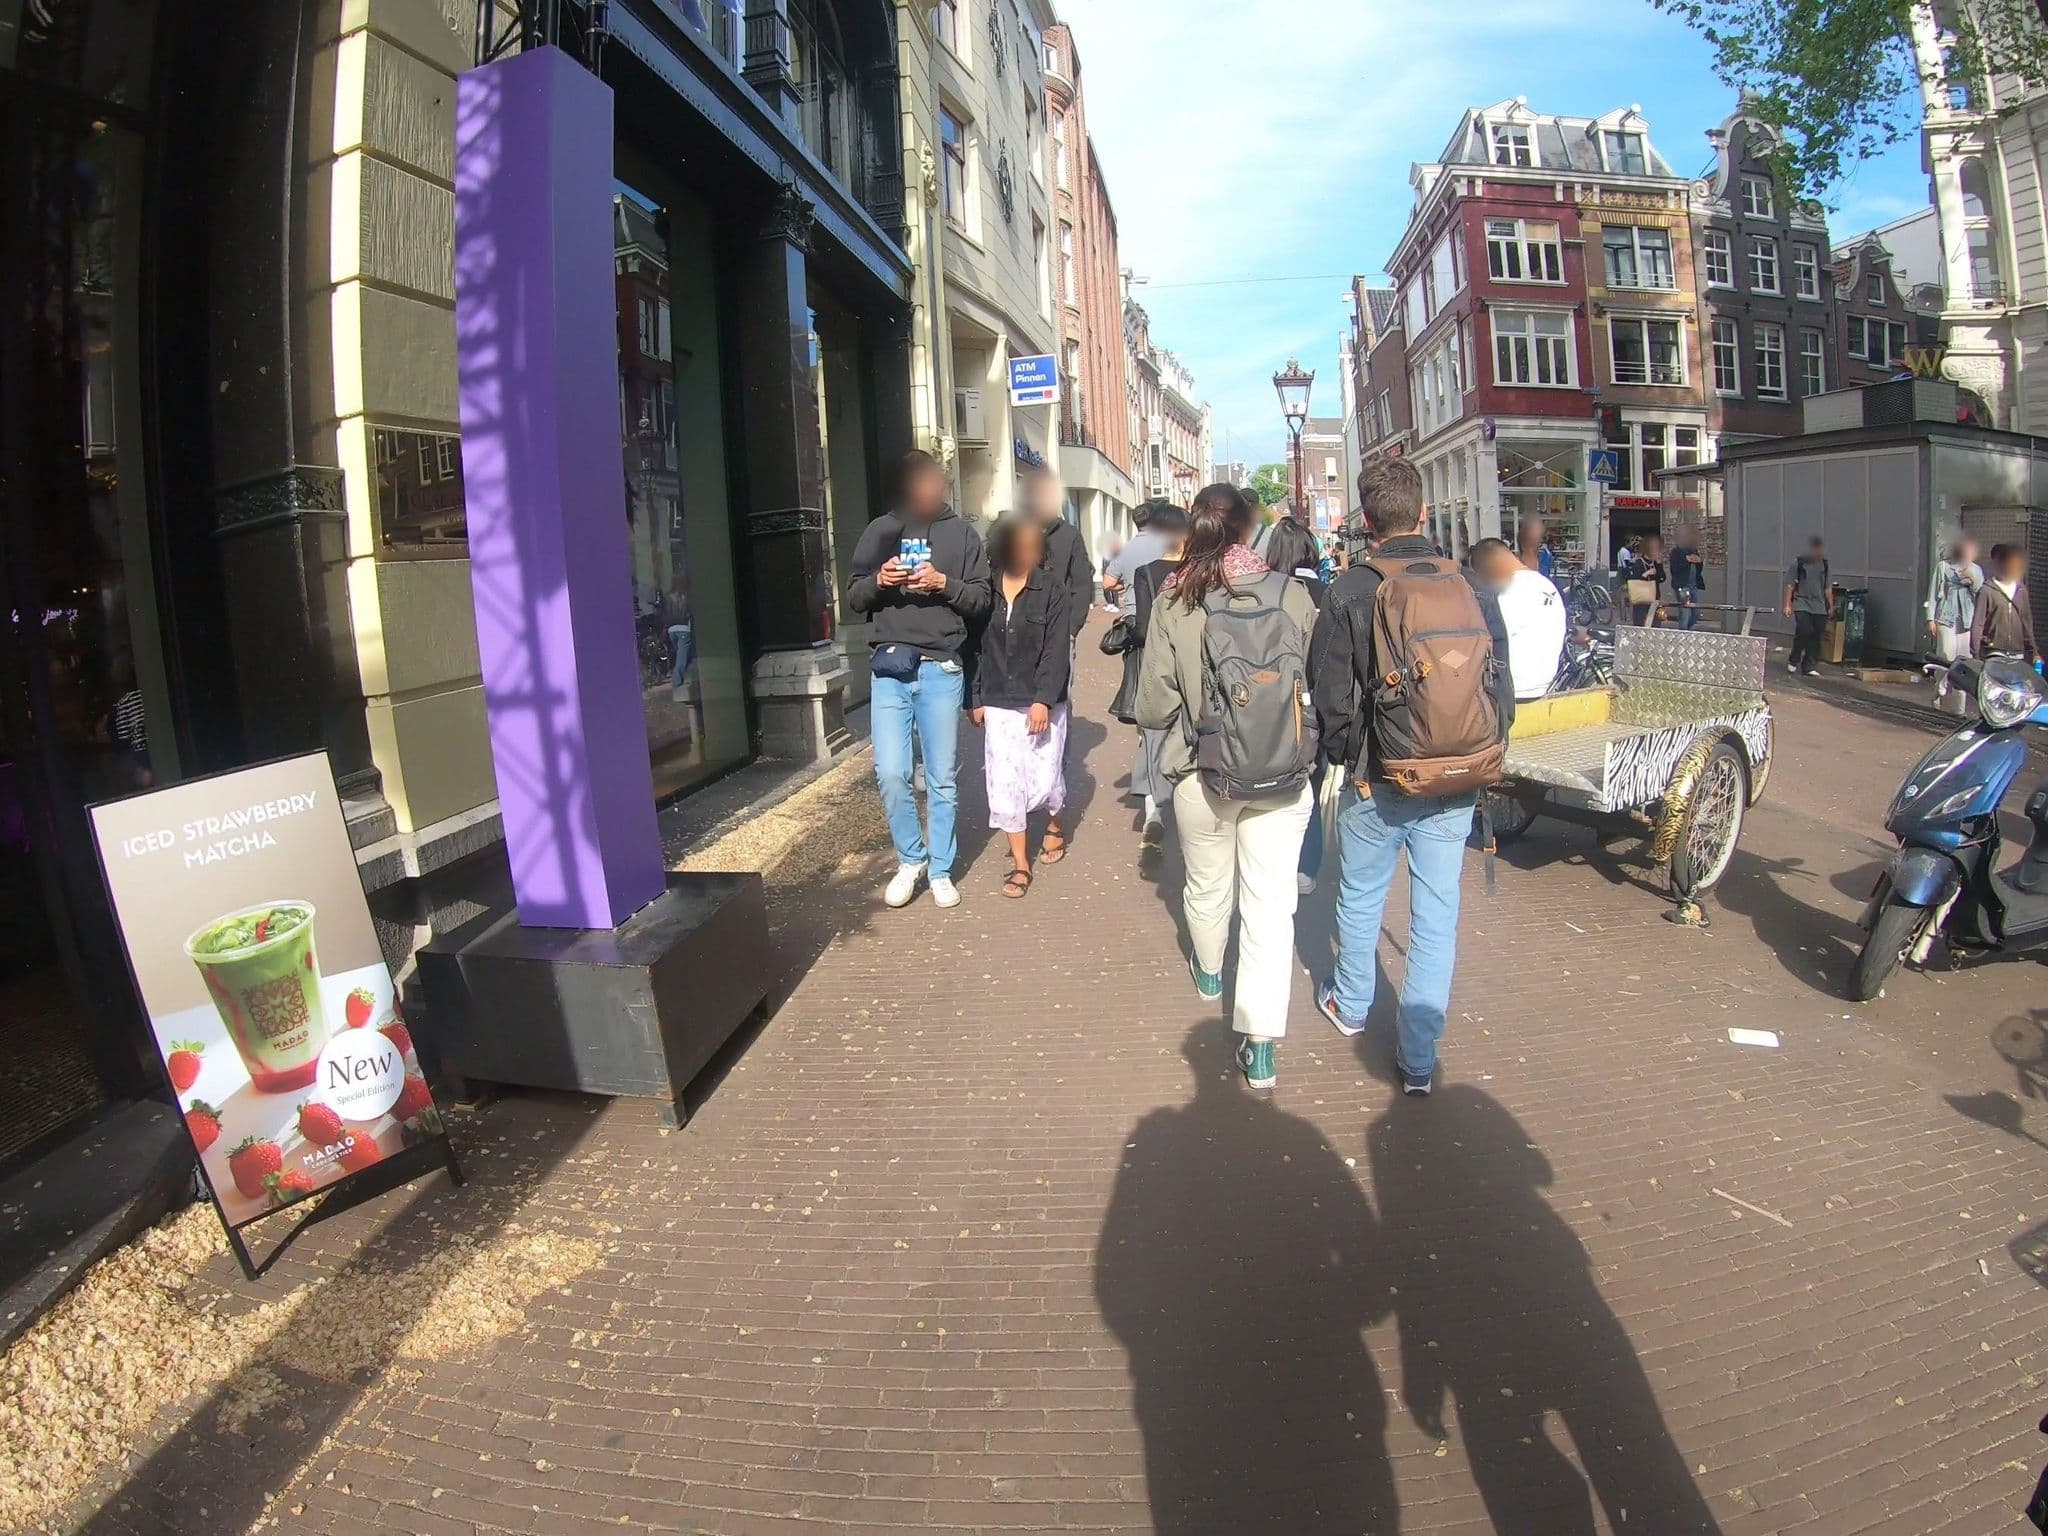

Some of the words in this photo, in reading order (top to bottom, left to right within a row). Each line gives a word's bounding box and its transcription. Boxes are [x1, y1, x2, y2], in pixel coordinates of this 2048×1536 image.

[1015, 362, 1036, 372] ATM
[1015, 374, 1047, 384] Pinnen
[122, 830, 175, 858] ICED
[183, 790, 317, 841] STRAWBERRY
[183, 830, 277, 869] MATCHA
[328, 1052, 392, 1090] New
[336, 1088, 366, 1106] Special
[367, 1082, 396, 1097] Edition
